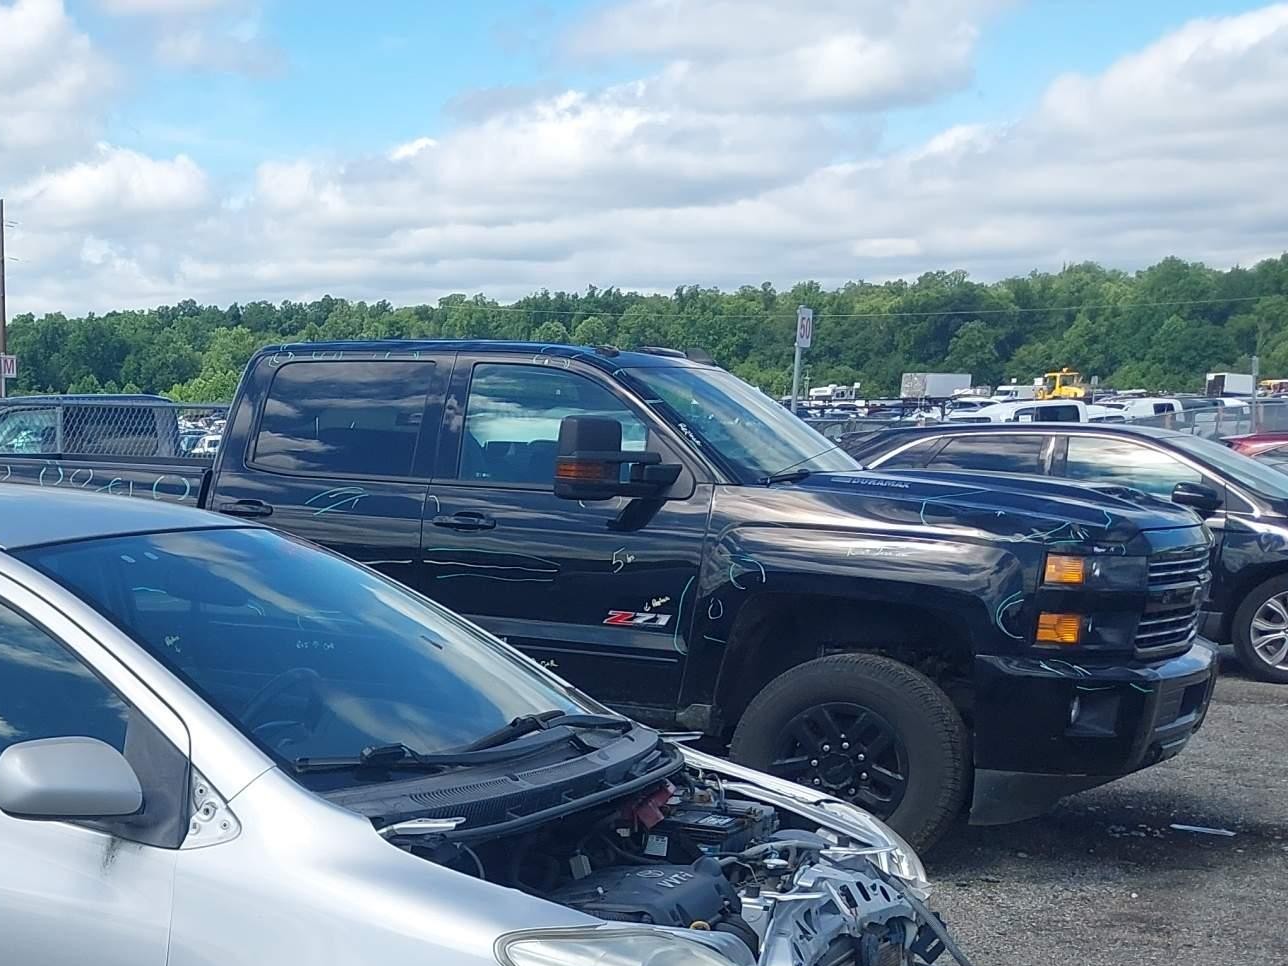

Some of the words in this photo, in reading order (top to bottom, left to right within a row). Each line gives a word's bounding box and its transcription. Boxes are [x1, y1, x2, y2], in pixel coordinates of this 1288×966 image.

[799, 316, 811, 339] 50
[4, 359, 15, 374] M
[851, 478, 911, 489] DURAMAX
[602, 610, 672, 626] Z71
